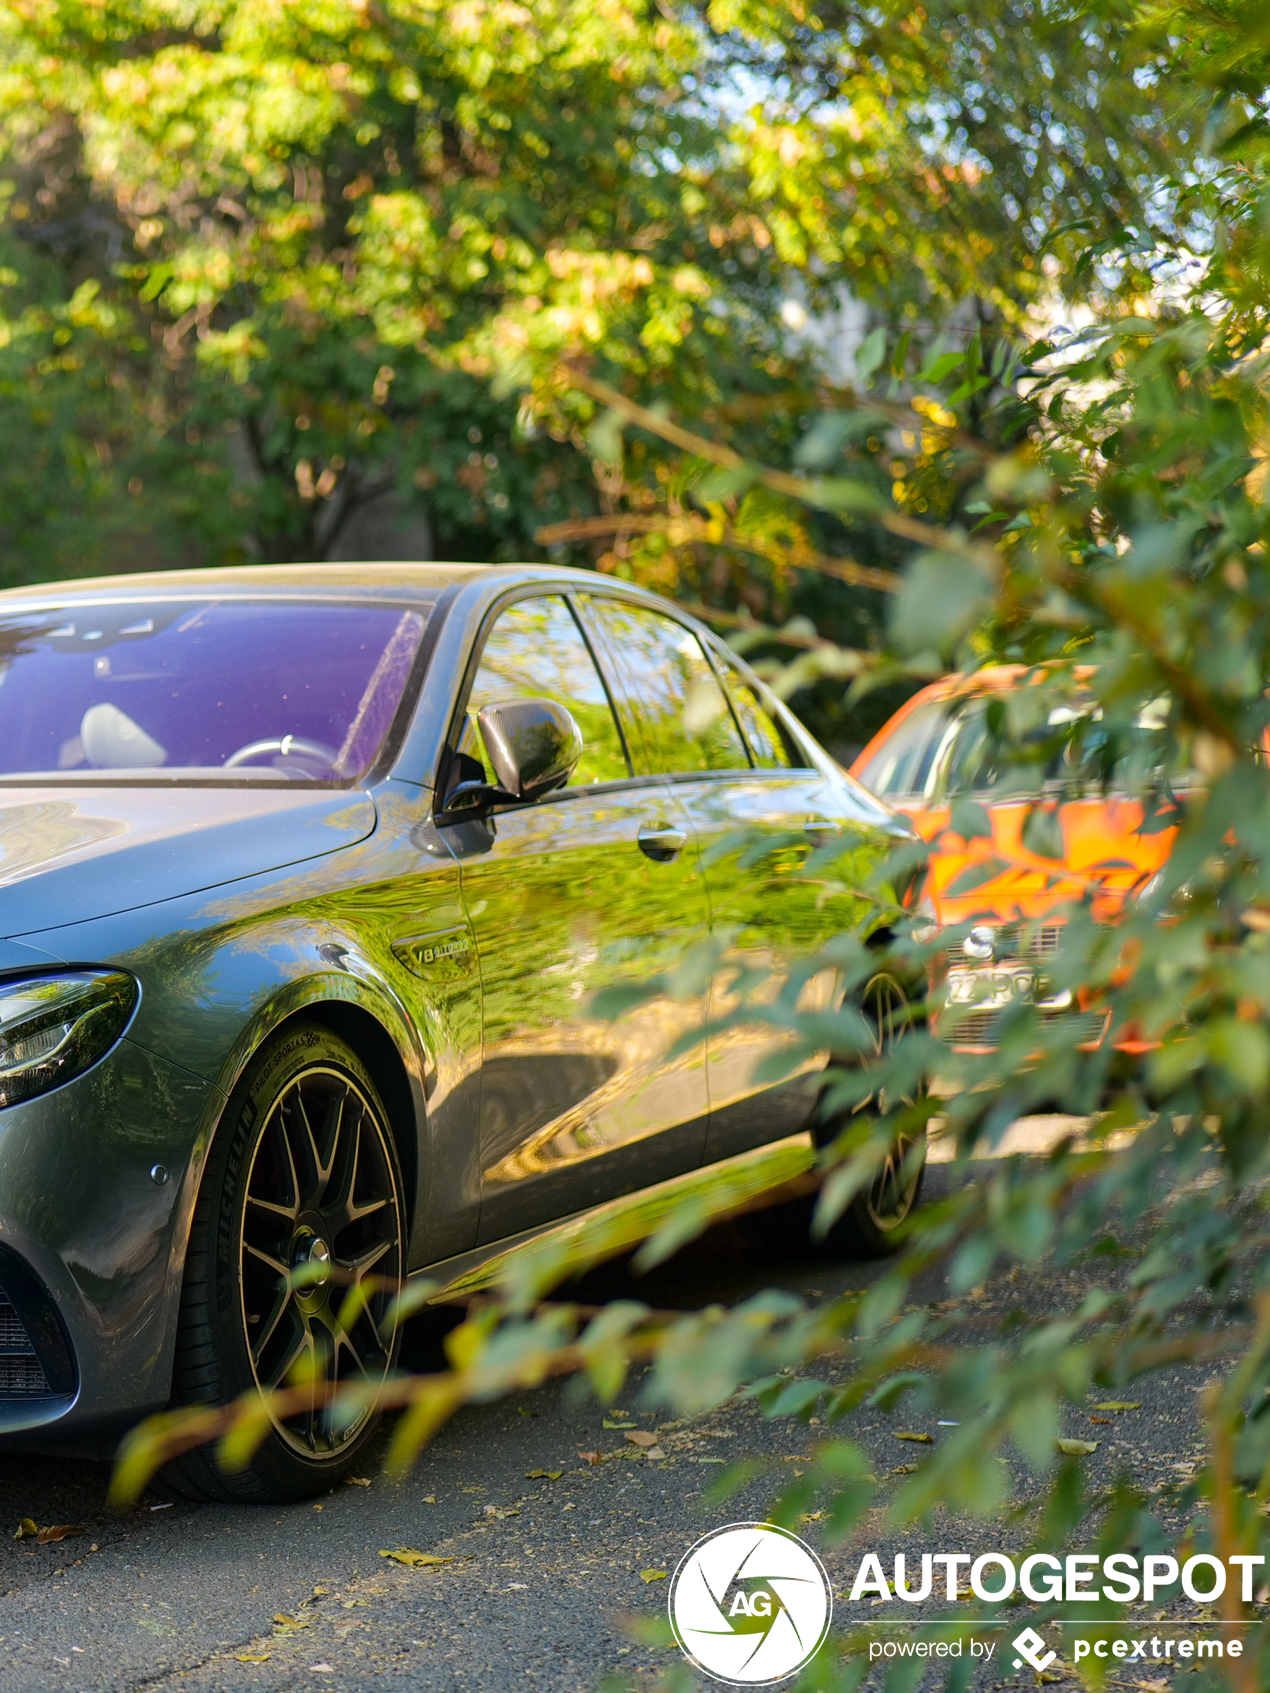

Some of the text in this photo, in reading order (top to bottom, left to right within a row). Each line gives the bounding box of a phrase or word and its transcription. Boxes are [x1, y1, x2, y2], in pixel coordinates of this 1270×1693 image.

[254, 1062, 272, 1093] PILOT
[273, 1041, 297, 1066] SPORT
[217, 1102, 255, 1264] MICHELIN
